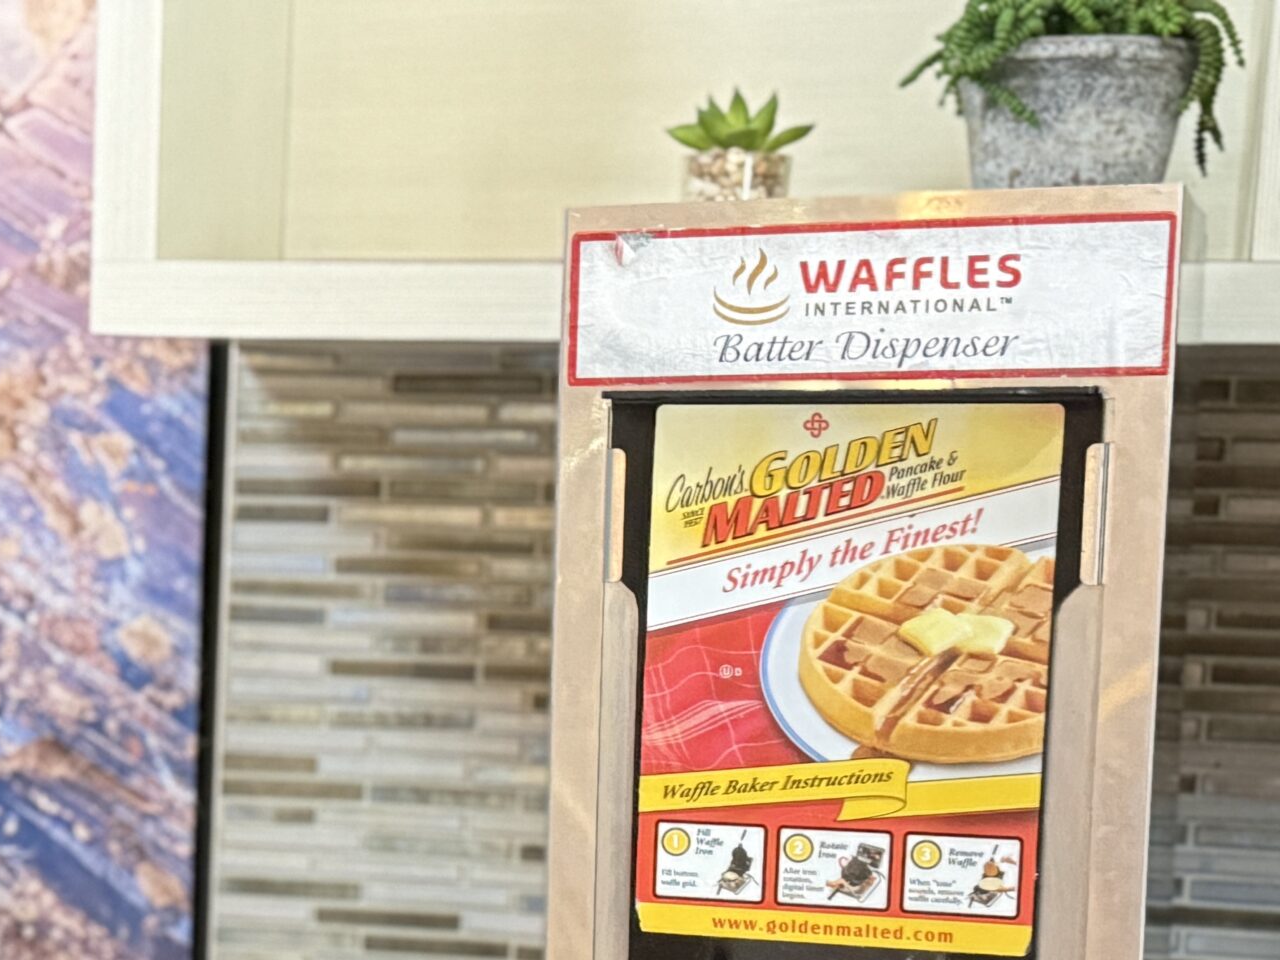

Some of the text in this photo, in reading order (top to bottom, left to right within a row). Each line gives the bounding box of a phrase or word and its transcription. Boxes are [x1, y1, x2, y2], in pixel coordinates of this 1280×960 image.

[800, 253, 1023, 294] WAFFLES
[713, 326, 1019, 370] Batter Dispenser
[665, 418, 938, 513] Carbon's GOLDEN
[888, 450, 959, 482] Pancake &
[886, 469, 967, 500] Waffle Flour
[701, 470, 886, 548] MALTED
[722, 507, 986, 593] Simply the Finest!
[662, 767, 895, 803] Waffle Baker Instructions
[671, 833, 680, 849] 1
[792, 840, 805, 856] 2
[920, 847, 932, 862] 3
[948, 858, 978, 870] Waffle
[711, 915, 955, 945] www.goldenmalted.com
